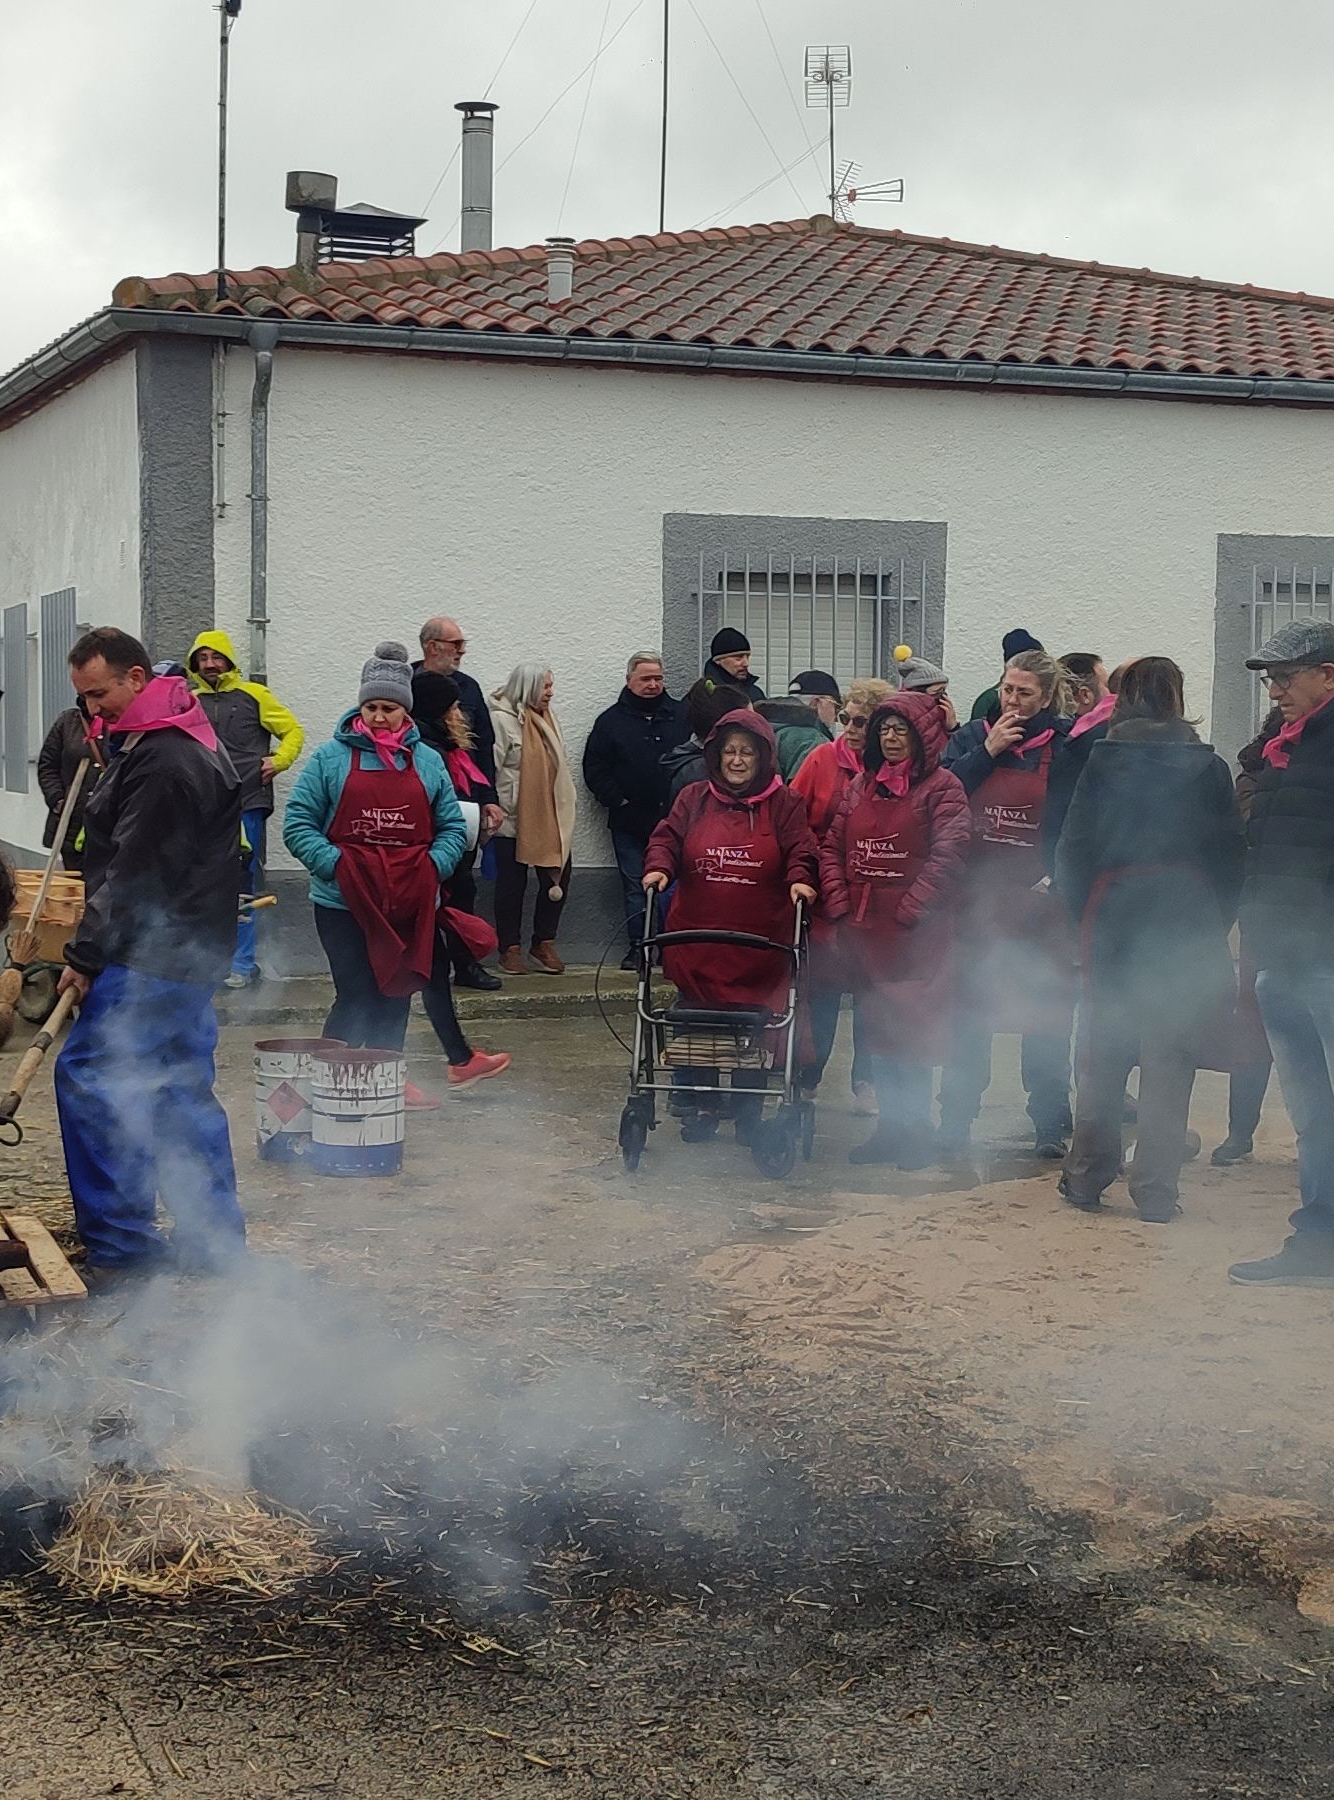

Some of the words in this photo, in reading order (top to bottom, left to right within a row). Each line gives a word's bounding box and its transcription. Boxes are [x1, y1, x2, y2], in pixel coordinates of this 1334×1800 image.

[361, 806, 408, 821] MATANZA
[984, 805, 1030, 820] MATANZA
[856, 835, 897, 851] MATANZA
[705, 845, 752, 859] MATANZA
